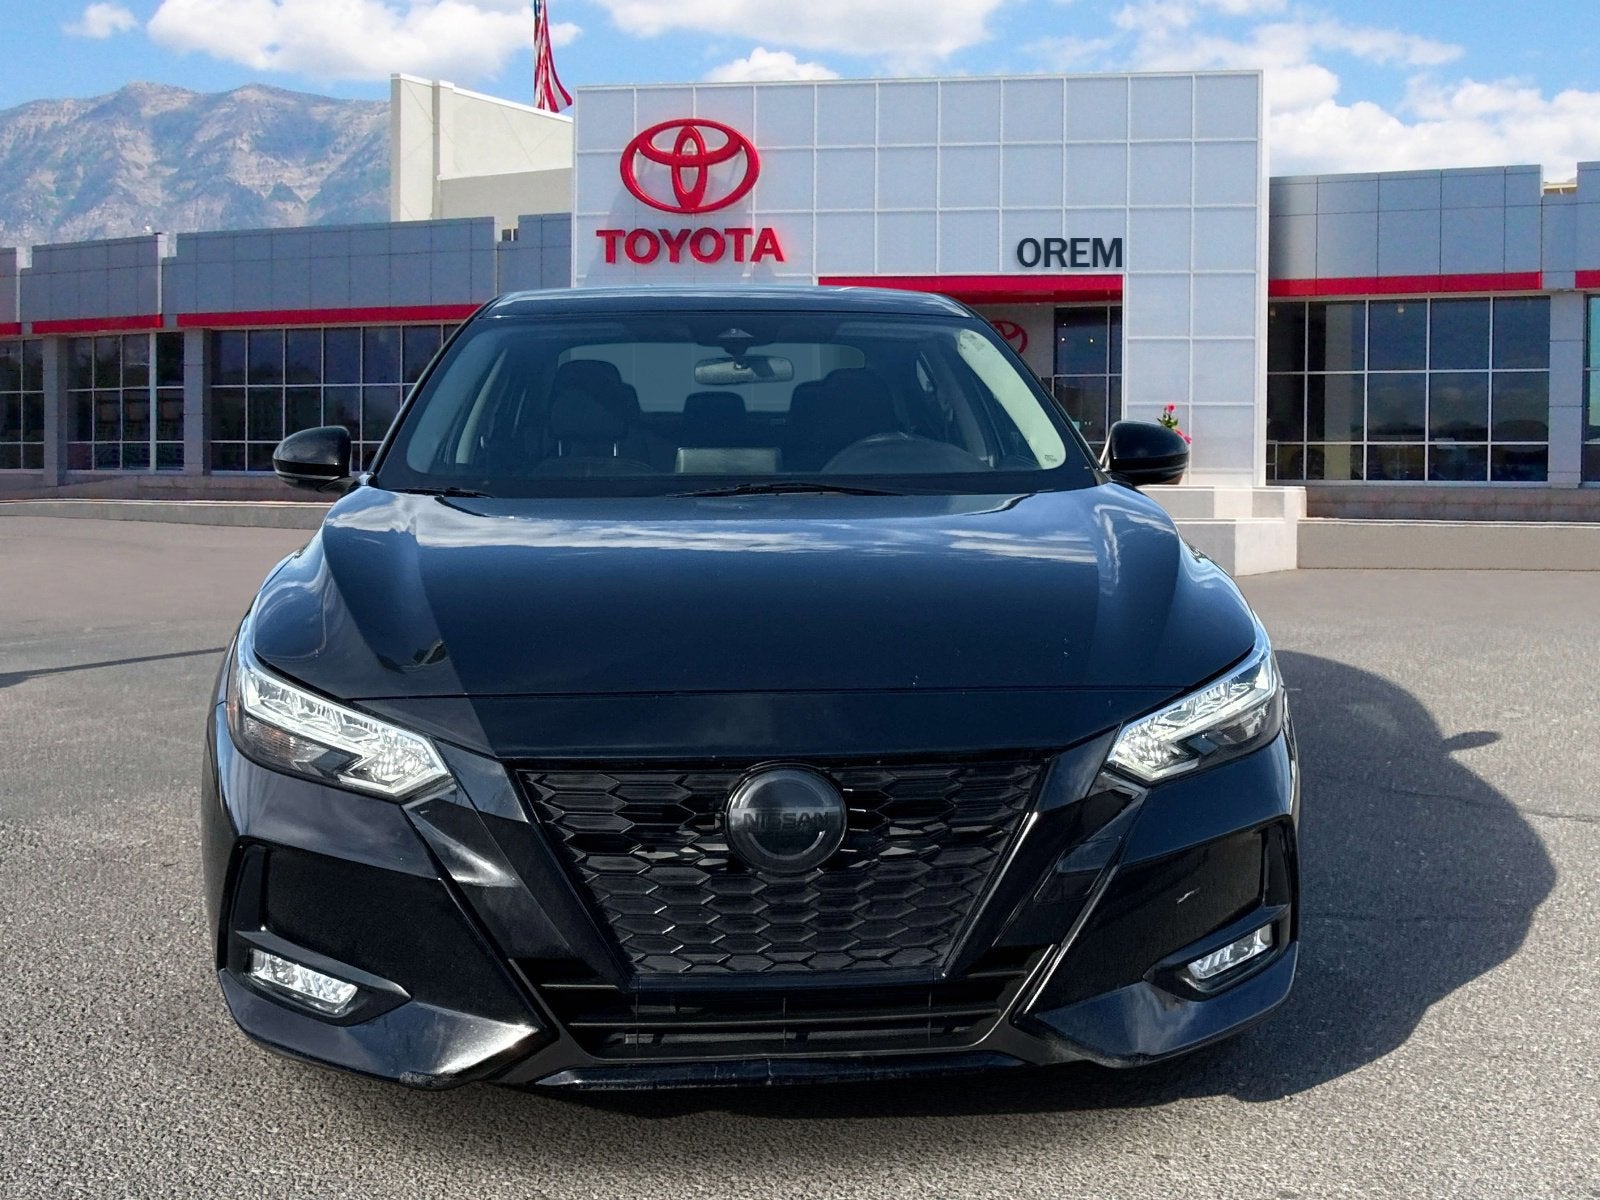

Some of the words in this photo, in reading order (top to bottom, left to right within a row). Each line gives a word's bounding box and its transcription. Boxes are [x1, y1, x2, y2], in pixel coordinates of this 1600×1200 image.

[596, 228, 784, 264] TOYOTA
[1016, 237, 1123, 268] OREM
[743, 811, 829, 831] NISSAN
